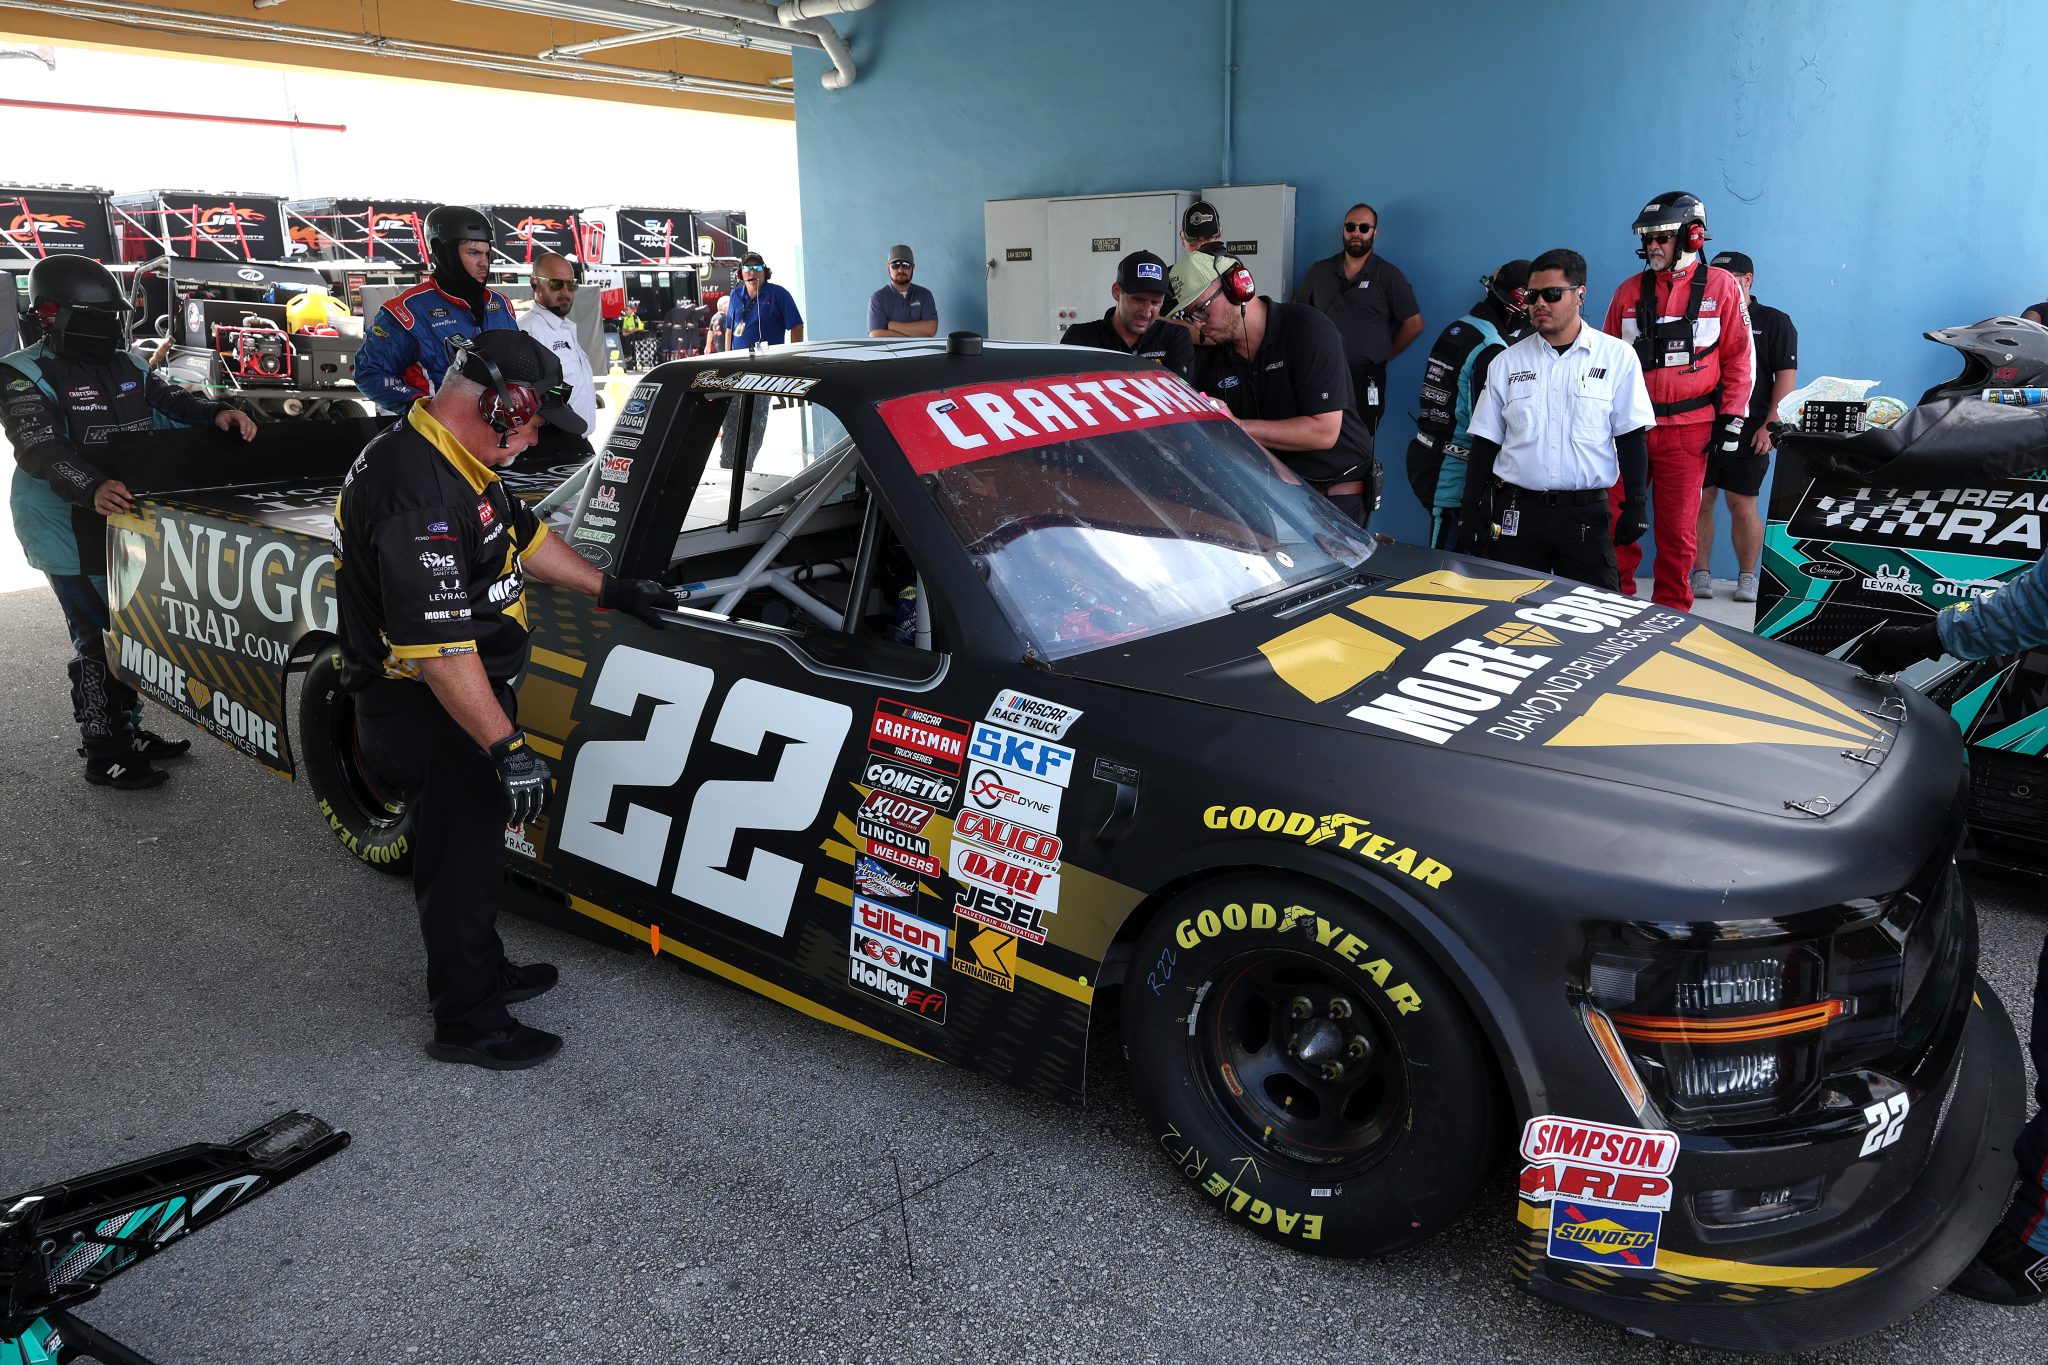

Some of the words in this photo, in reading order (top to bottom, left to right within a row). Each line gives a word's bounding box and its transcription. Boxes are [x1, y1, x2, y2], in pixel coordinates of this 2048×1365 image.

[733, 374, 817, 395] MUNIZ
[605, 458, 633, 472] MSG
[432, 554, 455, 567] MS
[1809, 564, 1844, 575] Colonial
[429, 591, 467, 602] LEVRAC
[1864, 579, 1919, 594] LEVRACK
[424, 610, 450, 621] MORE
[1346, 638, 1554, 745] MORE
[1515, 586, 1656, 634] CORE
[121, 634, 188, 703] MORE
[213, 690, 279, 759] CORE
[1486, 675, 1583, 742] DIAMOND
[1559, 637, 1639, 681] DRILLING
[140, 679, 178, 709] DIAMOND
[178, 698, 217, 734] DRILLING
[215, 719, 258, 757] SERVICES
[911, 710, 942, 726] NASCAR
[992, 708, 1024, 724] RACE
[1023, 716, 1062, 735] TRUCK
[1018, 698, 1068, 722] NASCAR
[875, 718, 961, 756] CRAFTSMAN
[970, 727, 1072, 777] SKF
[894, 747, 913, 759] TRUCK
[911, 750, 934, 765] SERIES
[558, 644, 853, 938] 22
[867, 765, 953, 803] COMETIC
[969, 779, 1051, 814] XCELDYNE
[870, 796, 929, 826] KLOTZ
[505, 837, 535, 857] VRACK
[860, 821, 927, 855] LINCOLN
[955, 810, 1060, 863] CALICO
[1203, 805, 1454, 890] GOODYEAR
[873, 844, 934, 873] WELDERS
[962, 852, 1050, 896] DART
[1006, 852, 1057, 872] COATINGS
[855, 863, 916, 893] Arrowhead
[955, 885, 1048, 936] JESEL
[958, 907, 998, 927] VALVETRAIN
[999, 922, 1040, 942] INNOVATION
[859, 903, 941, 954] tilton
[853, 932, 929, 979] KOOKS
[1175, 902, 1423, 1017] GOODYEAR
[851, 959, 909, 1006] Holley
[954, 958, 1012, 991] KENNAMETAL
[1858, 1091, 1911, 1158] 22
[1533, 1124, 1666, 1168] SIMPSON
[1519, 1164, 1670, 1203] ARP
[1201, 1172, 1324, 1241] EAGLE
[1558, 1225, 1652, 1247] SUNOCO
